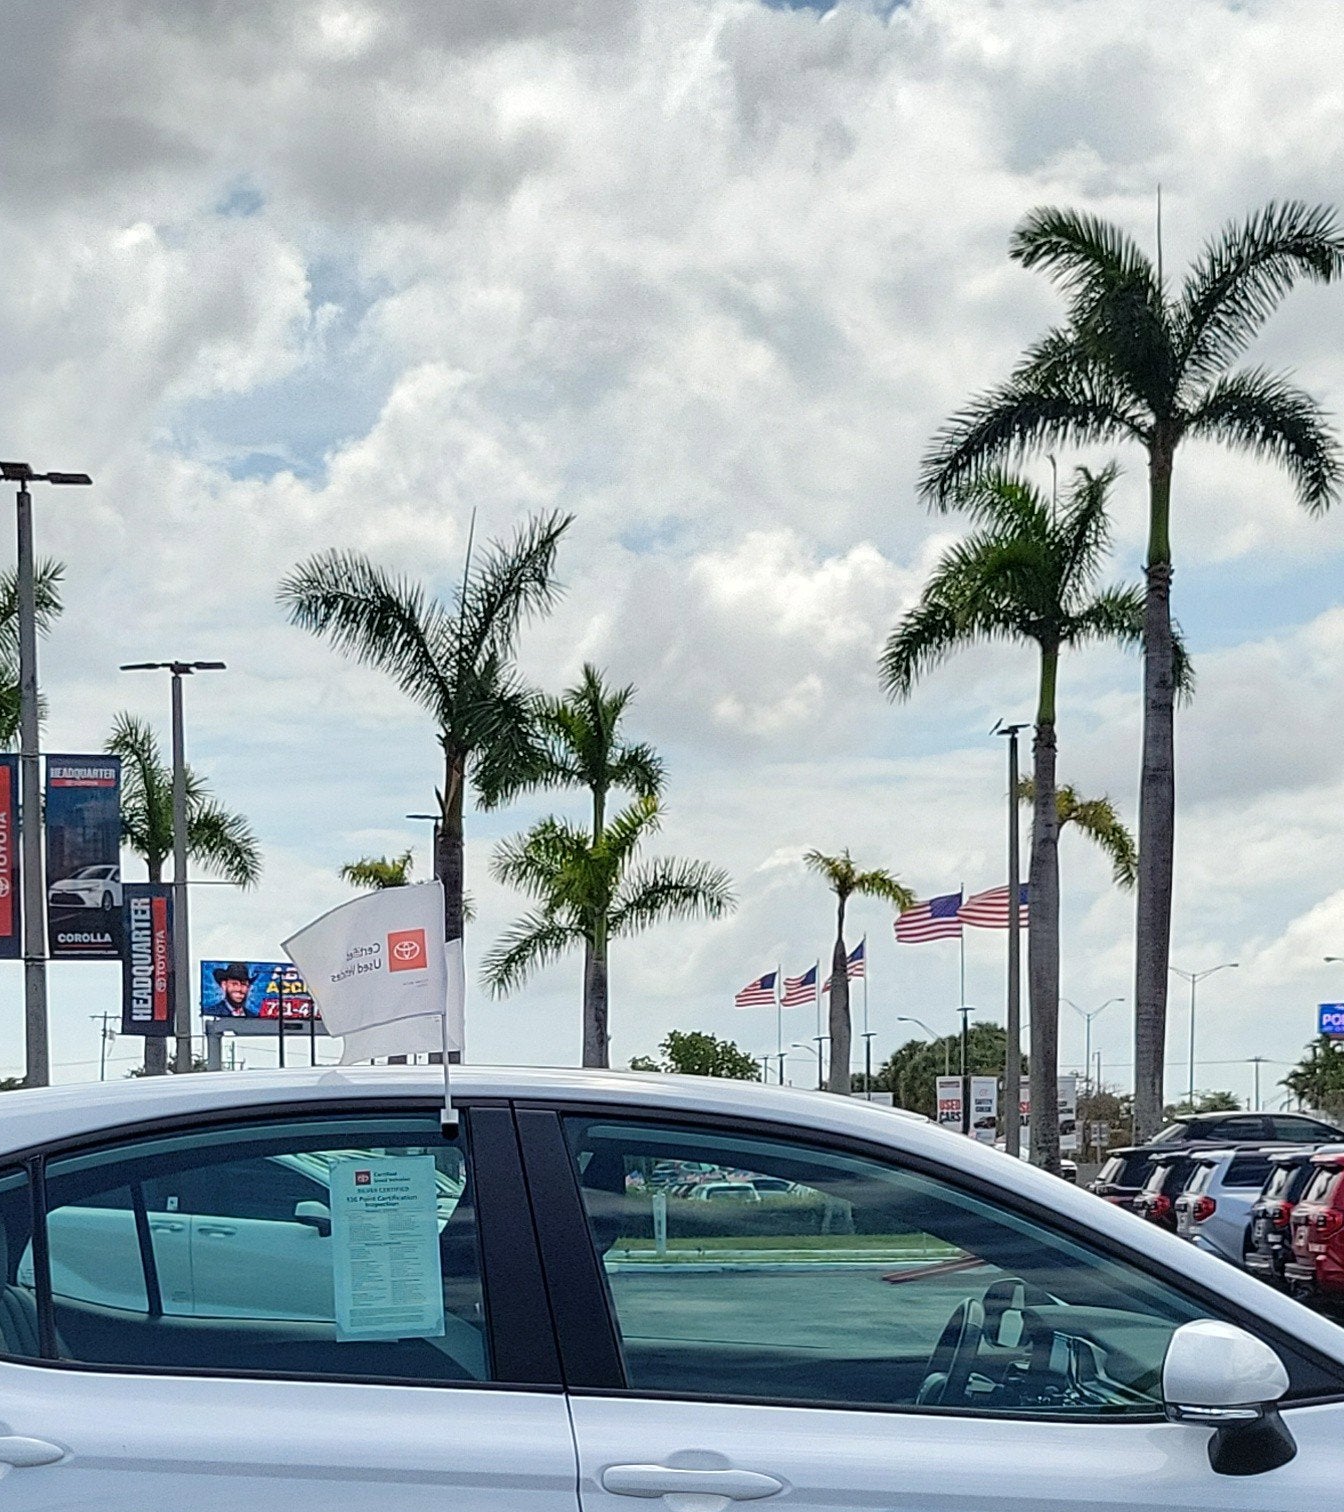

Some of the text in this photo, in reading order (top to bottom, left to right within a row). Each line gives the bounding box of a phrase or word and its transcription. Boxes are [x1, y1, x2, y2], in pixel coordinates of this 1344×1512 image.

[57, 933, 112, 943] COROLLA
[130, 898, 154, 1021] HEADQUARTER
[156, 930, 166, 976] TOYOTA
